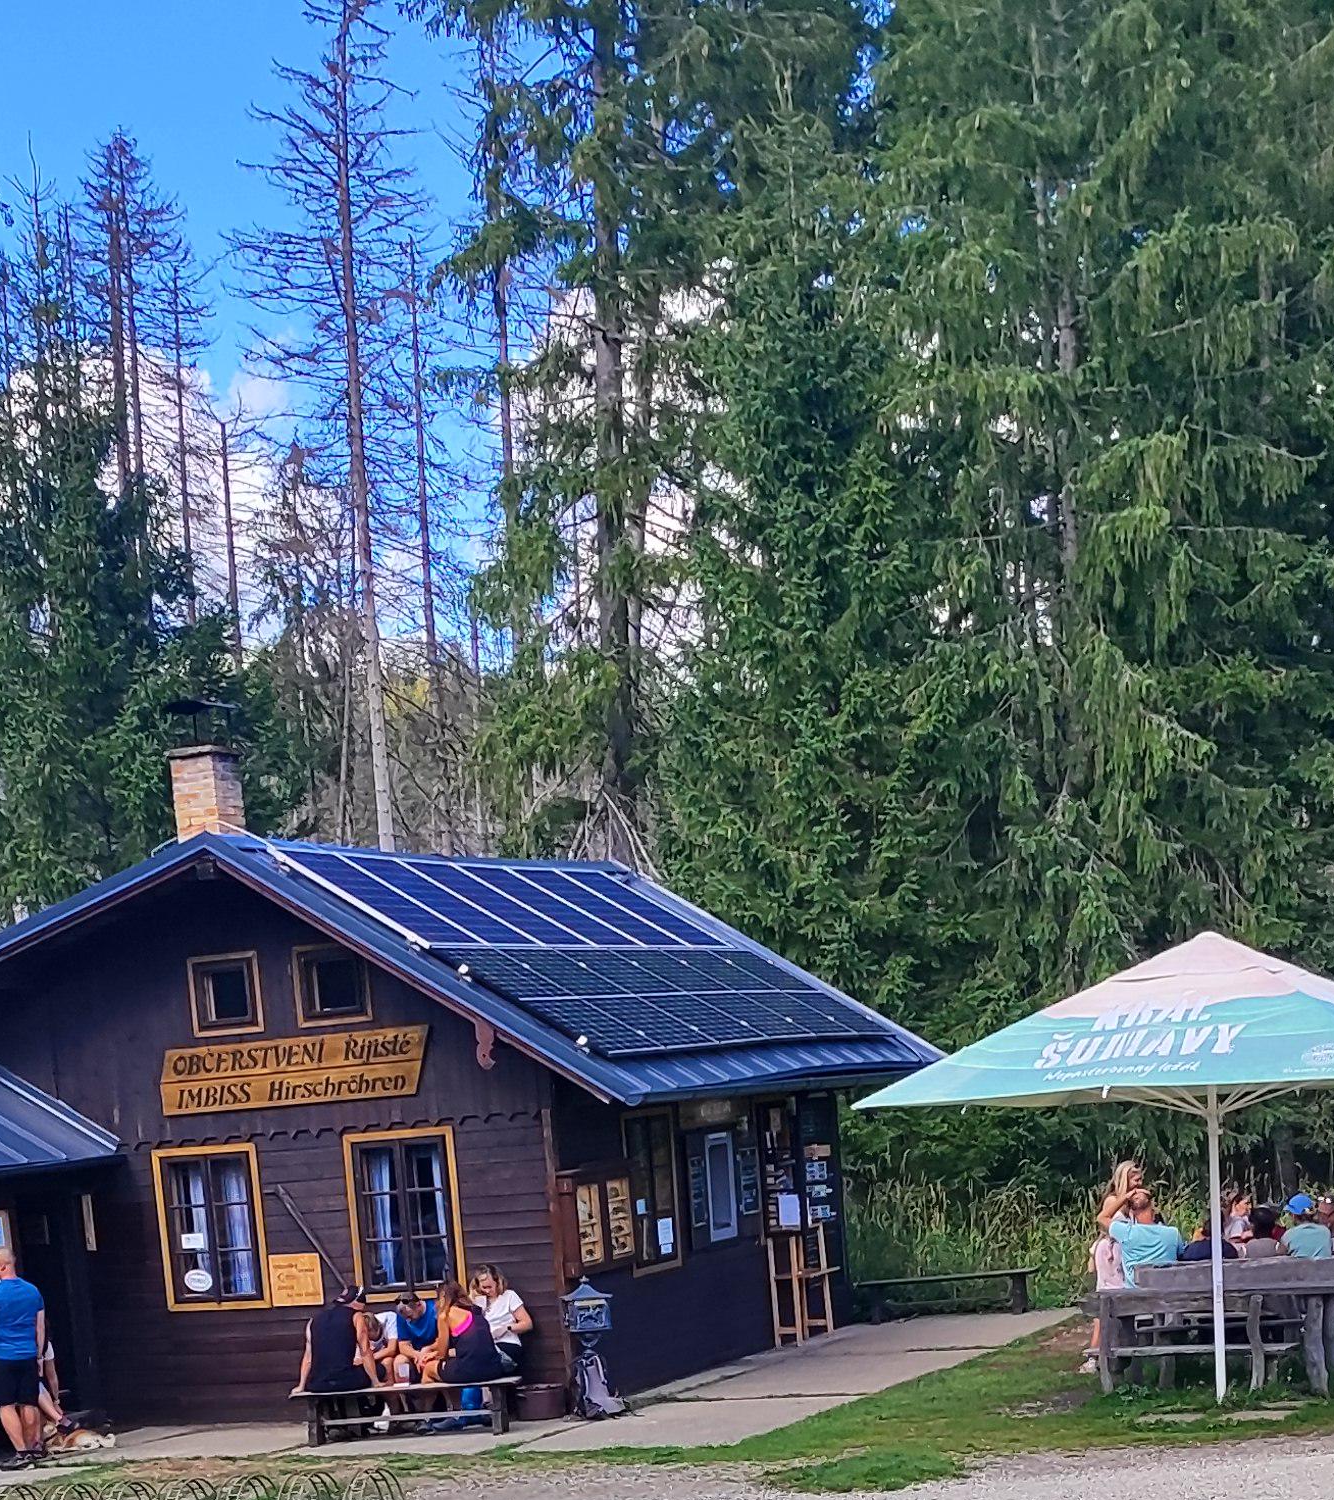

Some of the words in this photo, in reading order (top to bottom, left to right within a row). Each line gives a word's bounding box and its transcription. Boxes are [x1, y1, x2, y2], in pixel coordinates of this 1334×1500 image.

[1091, 989, 1212, 1032] KRÁL
[172, 1038, 325, 1076] OBČERSTVENÍ
[1033, 1023, 1247, 1069] ŠUMAVY
[177, 1081, 252, 1110] IMBISS
[268, 1072, 407, 1101] Hirschröhren
